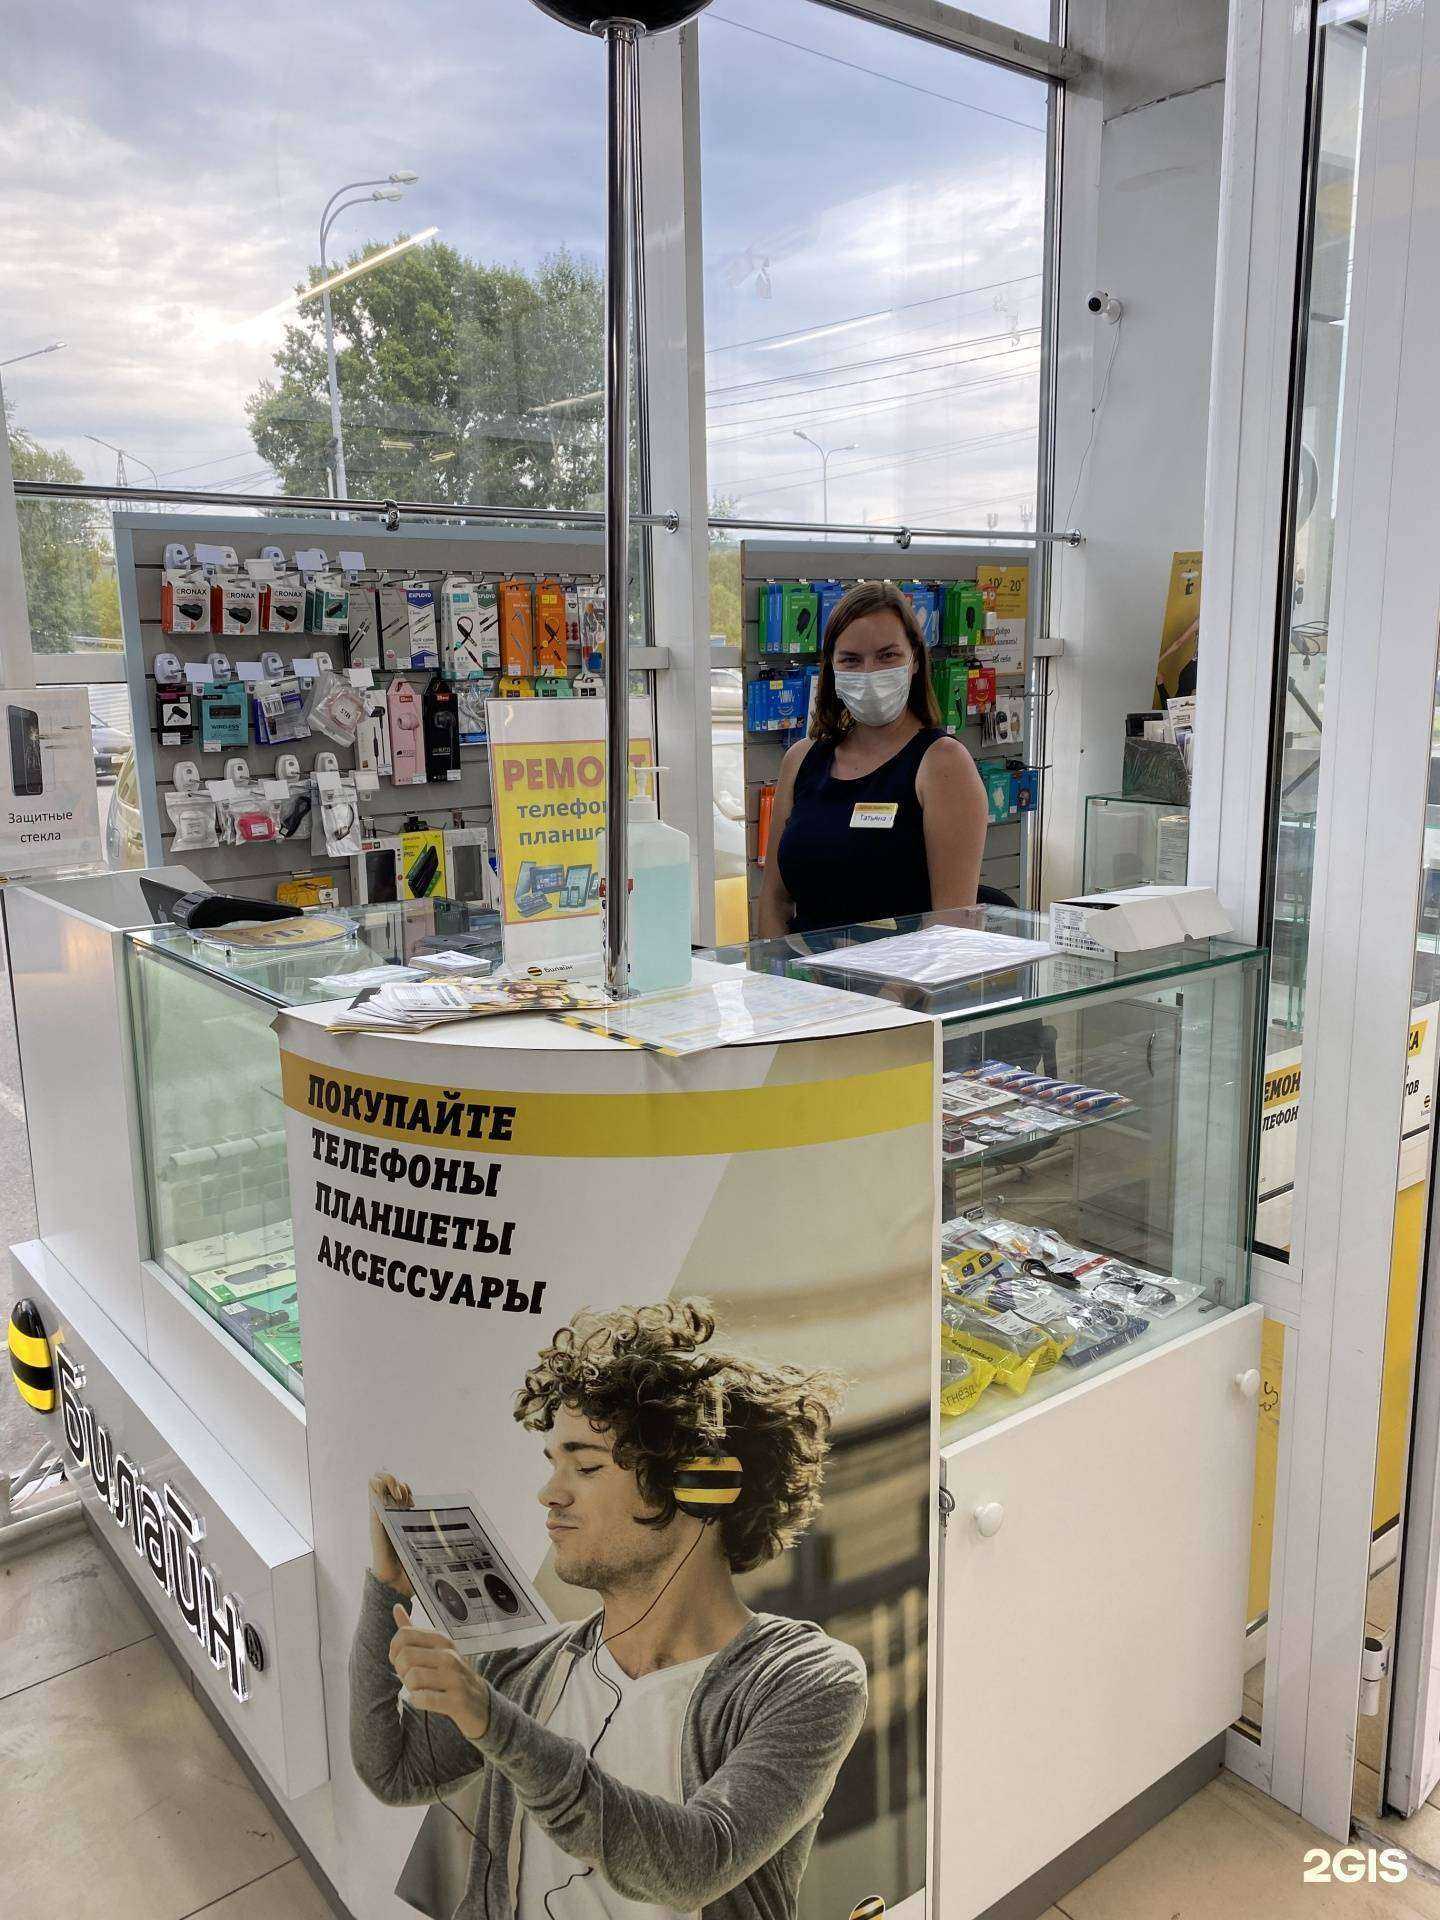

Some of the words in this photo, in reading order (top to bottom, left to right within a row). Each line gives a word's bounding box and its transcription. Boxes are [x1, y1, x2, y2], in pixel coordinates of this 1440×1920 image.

[503, 754, 646, 792] РЕМОТ
[8, 811, 73, 824] Защитные
[516, 797, 607, 819] телефо
[20, 831, 61, 843] стекла
[308, 1074, 517, 1141] ПОКУПАЙТЕ
[312, 1127, 501, 1197] ТЕЛЕФОНЫ
[315, 1181, 516, 1255] ПЛАНШЕТЫ
[318, 1235, 547, 1314] АКСЕССУАРЫ
